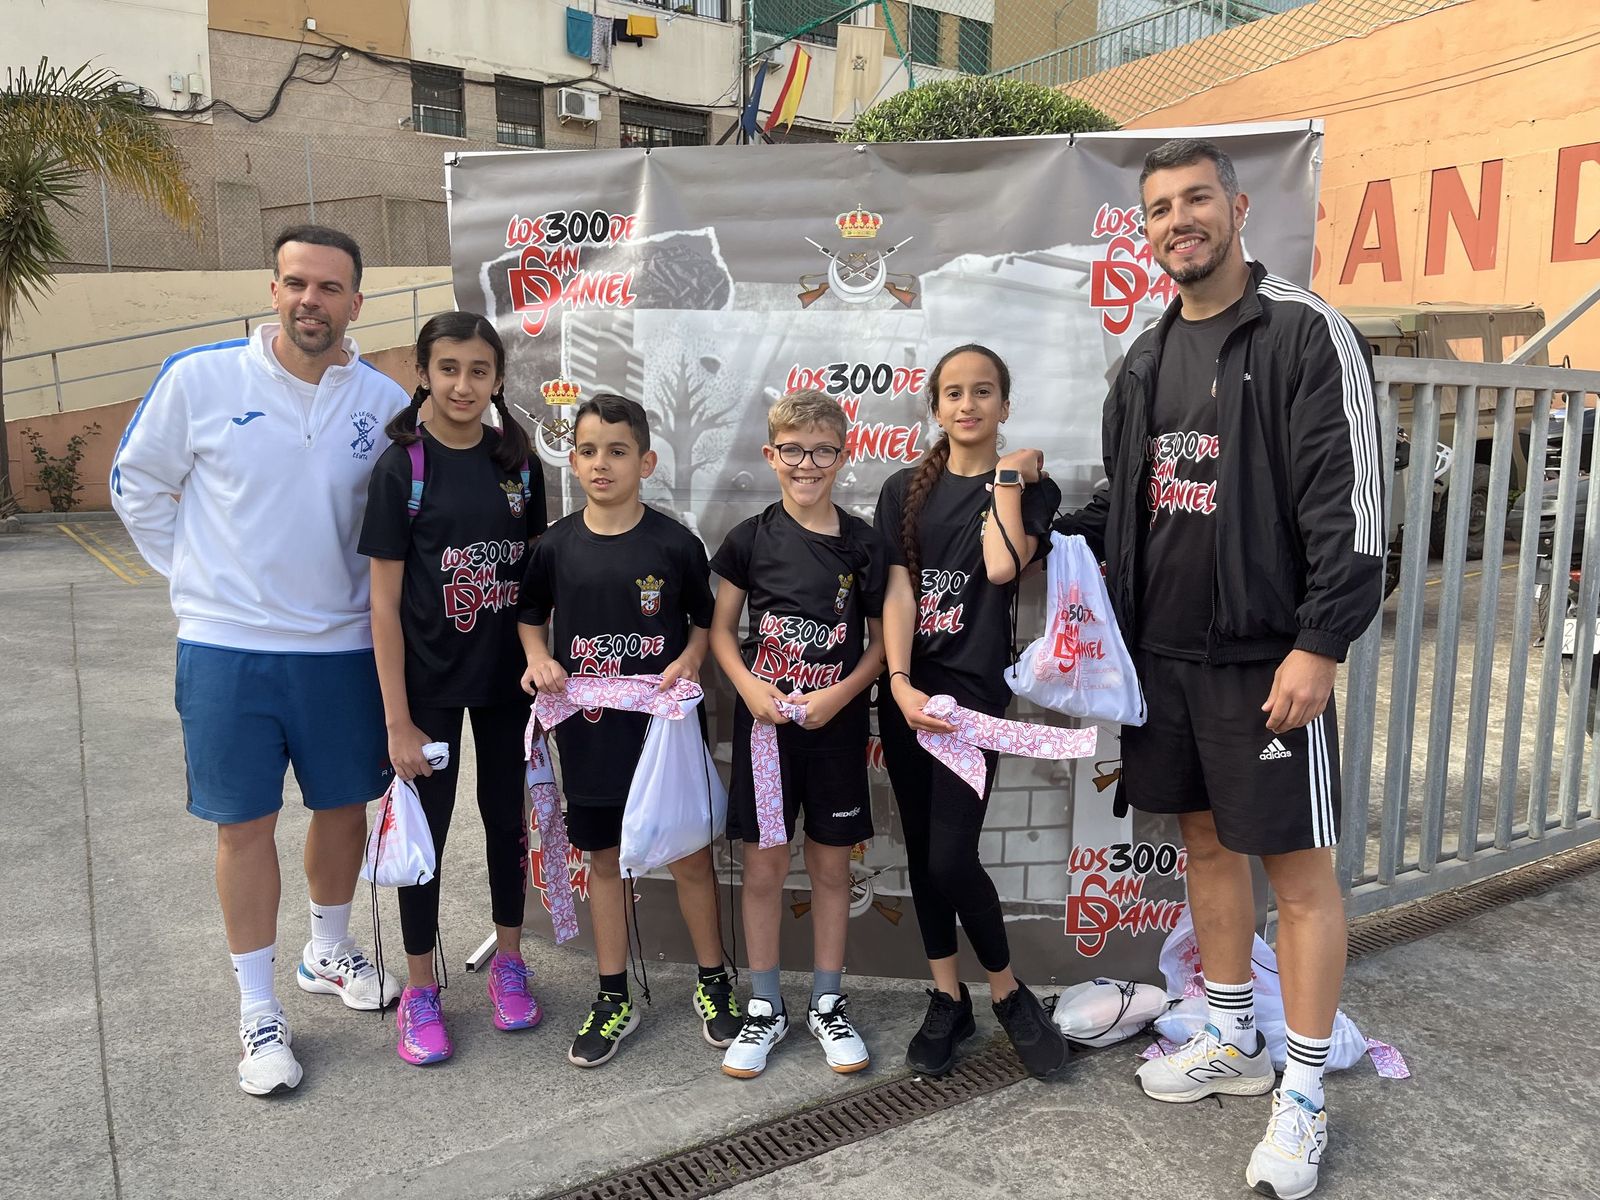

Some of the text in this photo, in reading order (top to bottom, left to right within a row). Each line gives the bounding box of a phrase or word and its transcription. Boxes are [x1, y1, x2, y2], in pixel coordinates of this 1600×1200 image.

[1312, 157, 1503, 285] AN
[507, 267, 637, 313] DANIEL
[845, 421, 924, 467] ANIEL
[1259, 750, 1292, 761] adidas
